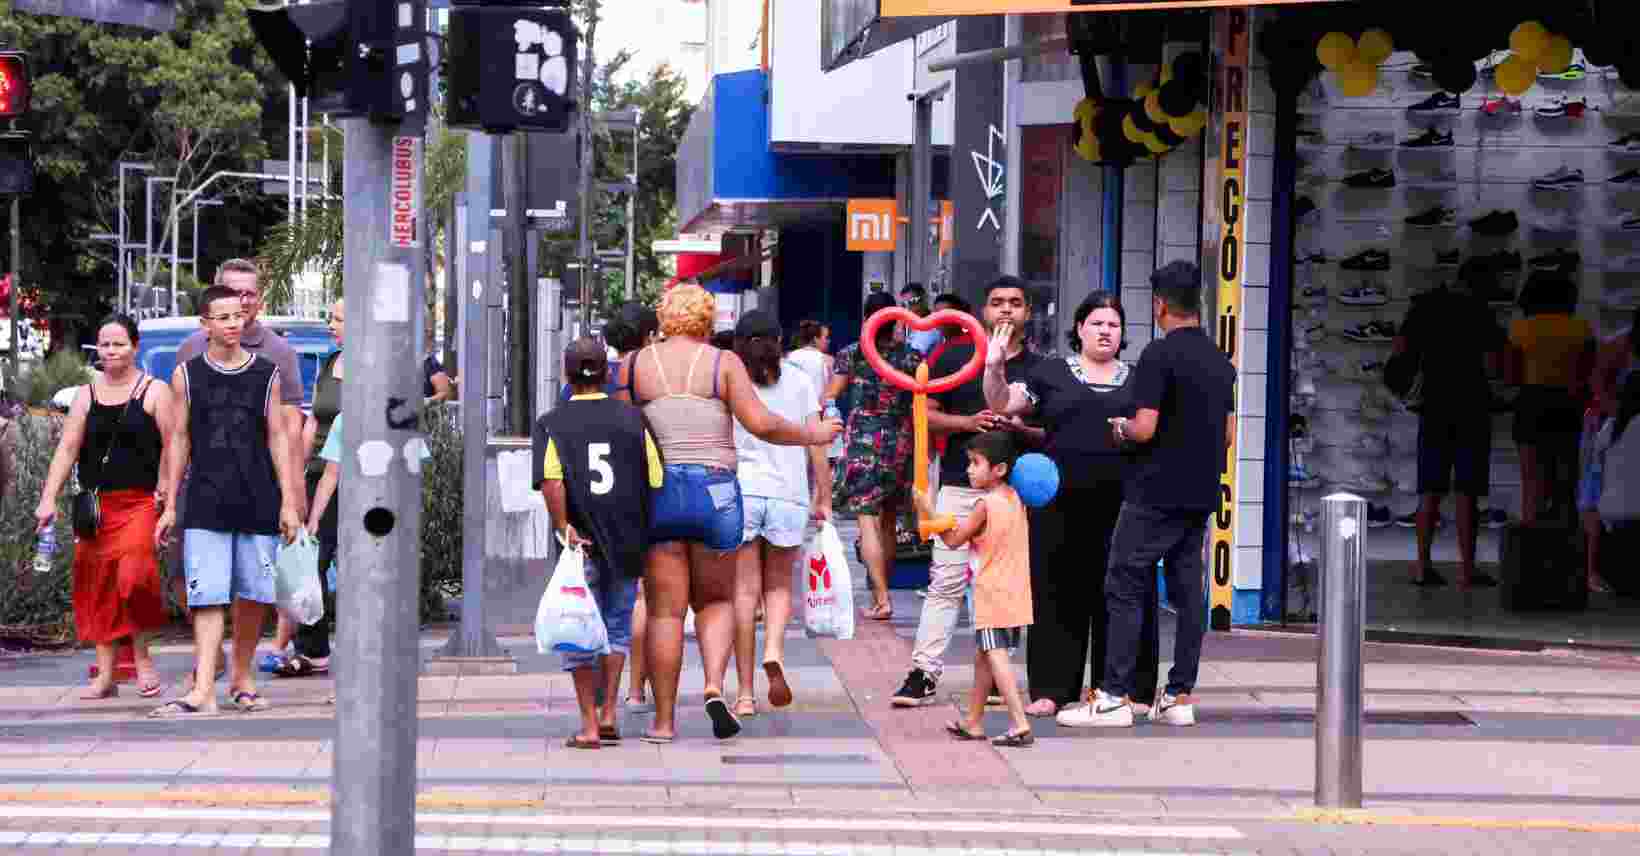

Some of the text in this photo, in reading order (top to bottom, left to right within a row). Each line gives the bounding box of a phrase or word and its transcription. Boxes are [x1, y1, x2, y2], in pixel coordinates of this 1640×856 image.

[395, 137, 414, 247] HERCOLUBUS
[1222, 10, 1246, 281] PREÇO
[588, 442, 615, 495] 5
